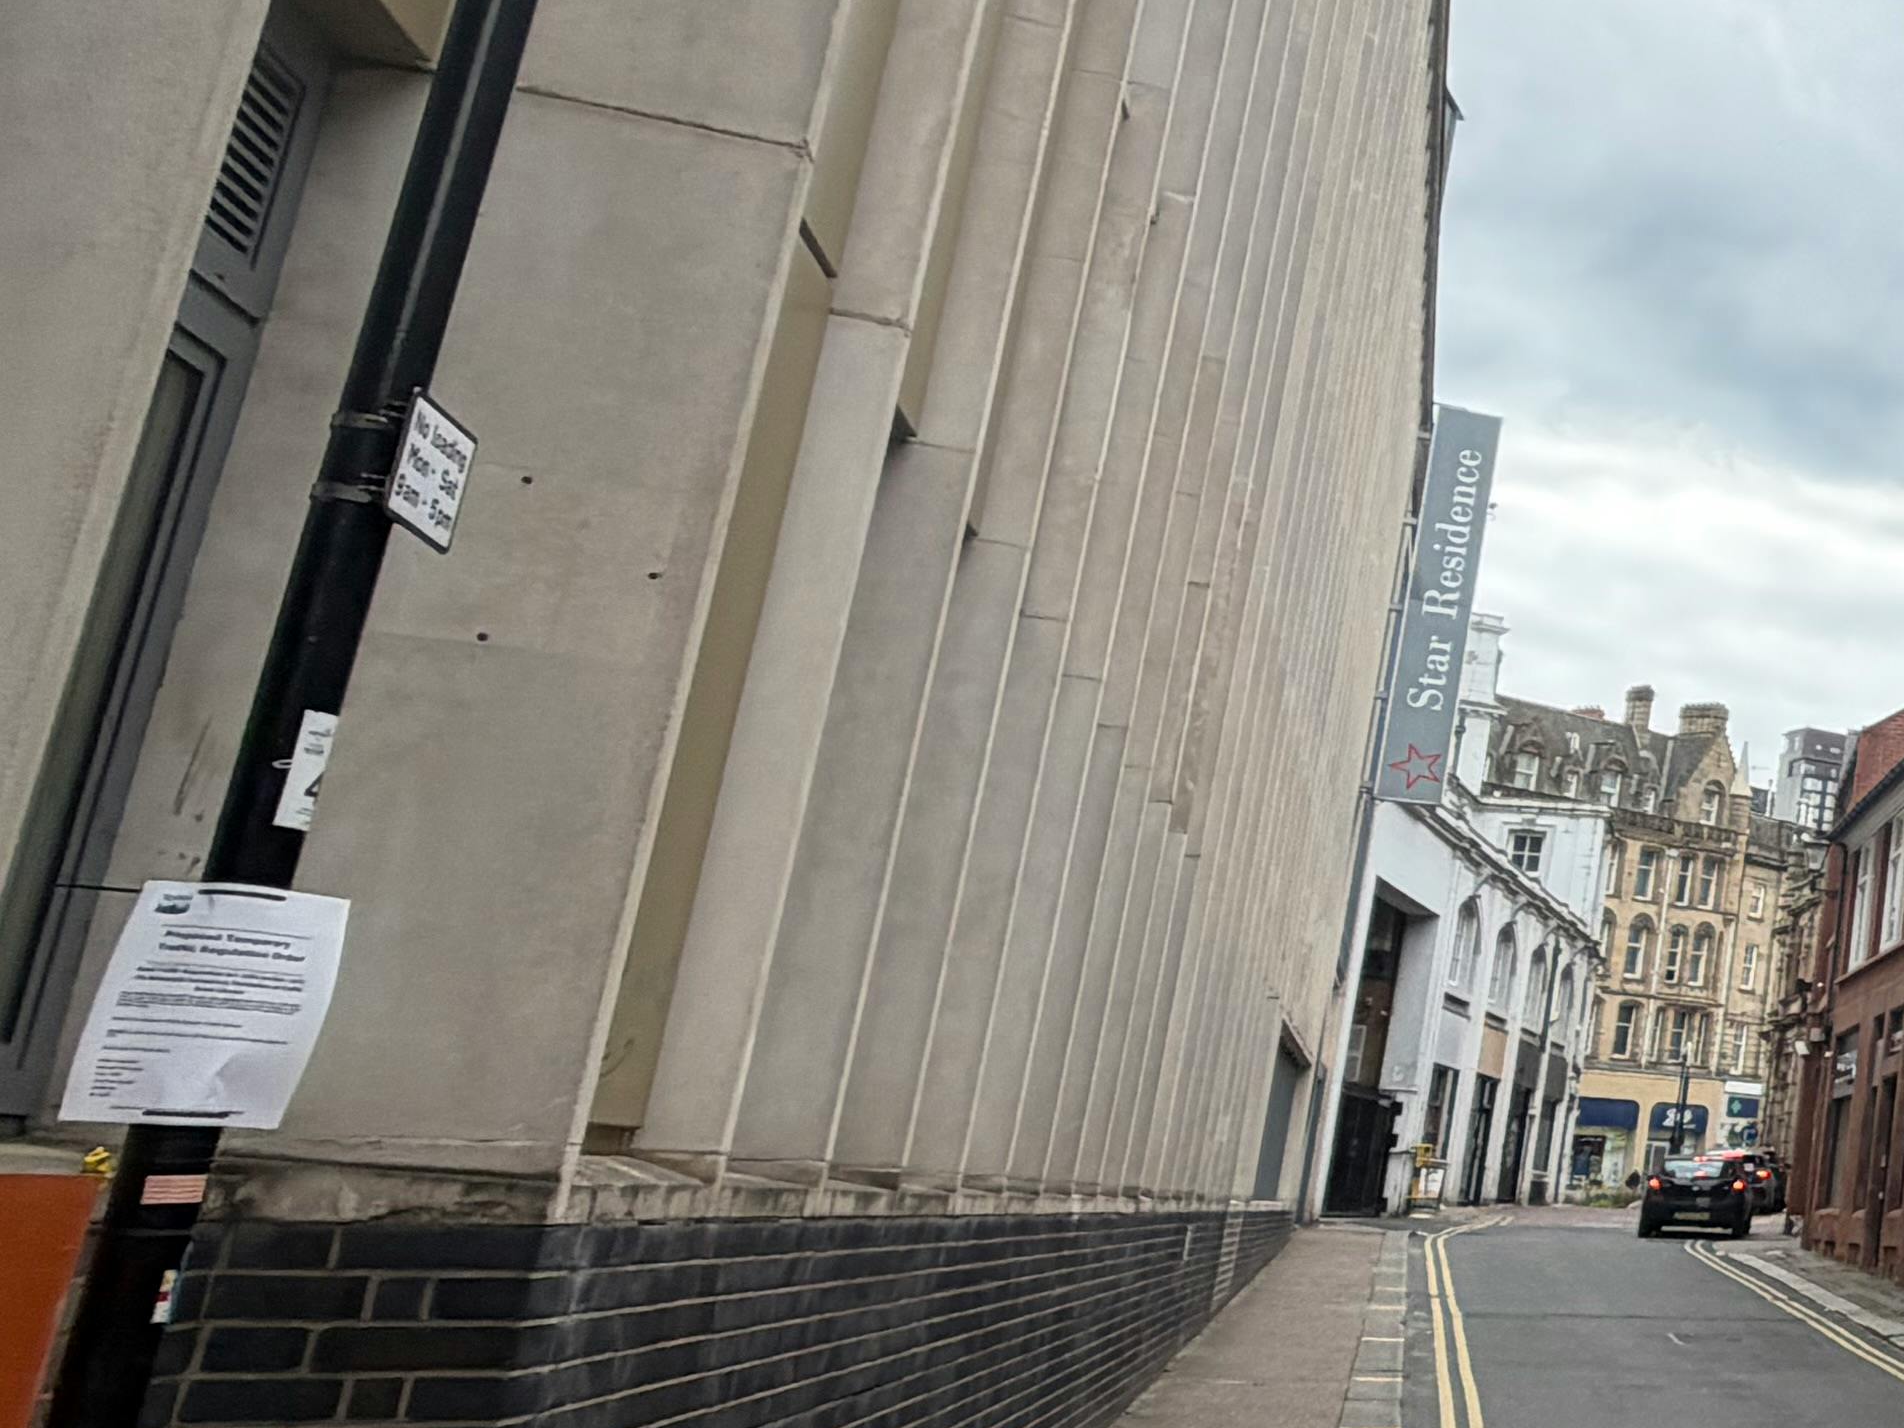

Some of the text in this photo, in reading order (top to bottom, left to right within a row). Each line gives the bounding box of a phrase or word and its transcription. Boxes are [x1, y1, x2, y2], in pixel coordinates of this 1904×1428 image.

[414, 410, 467, 474] No loading
[1406, 448, 1483, 712] Star Residence
